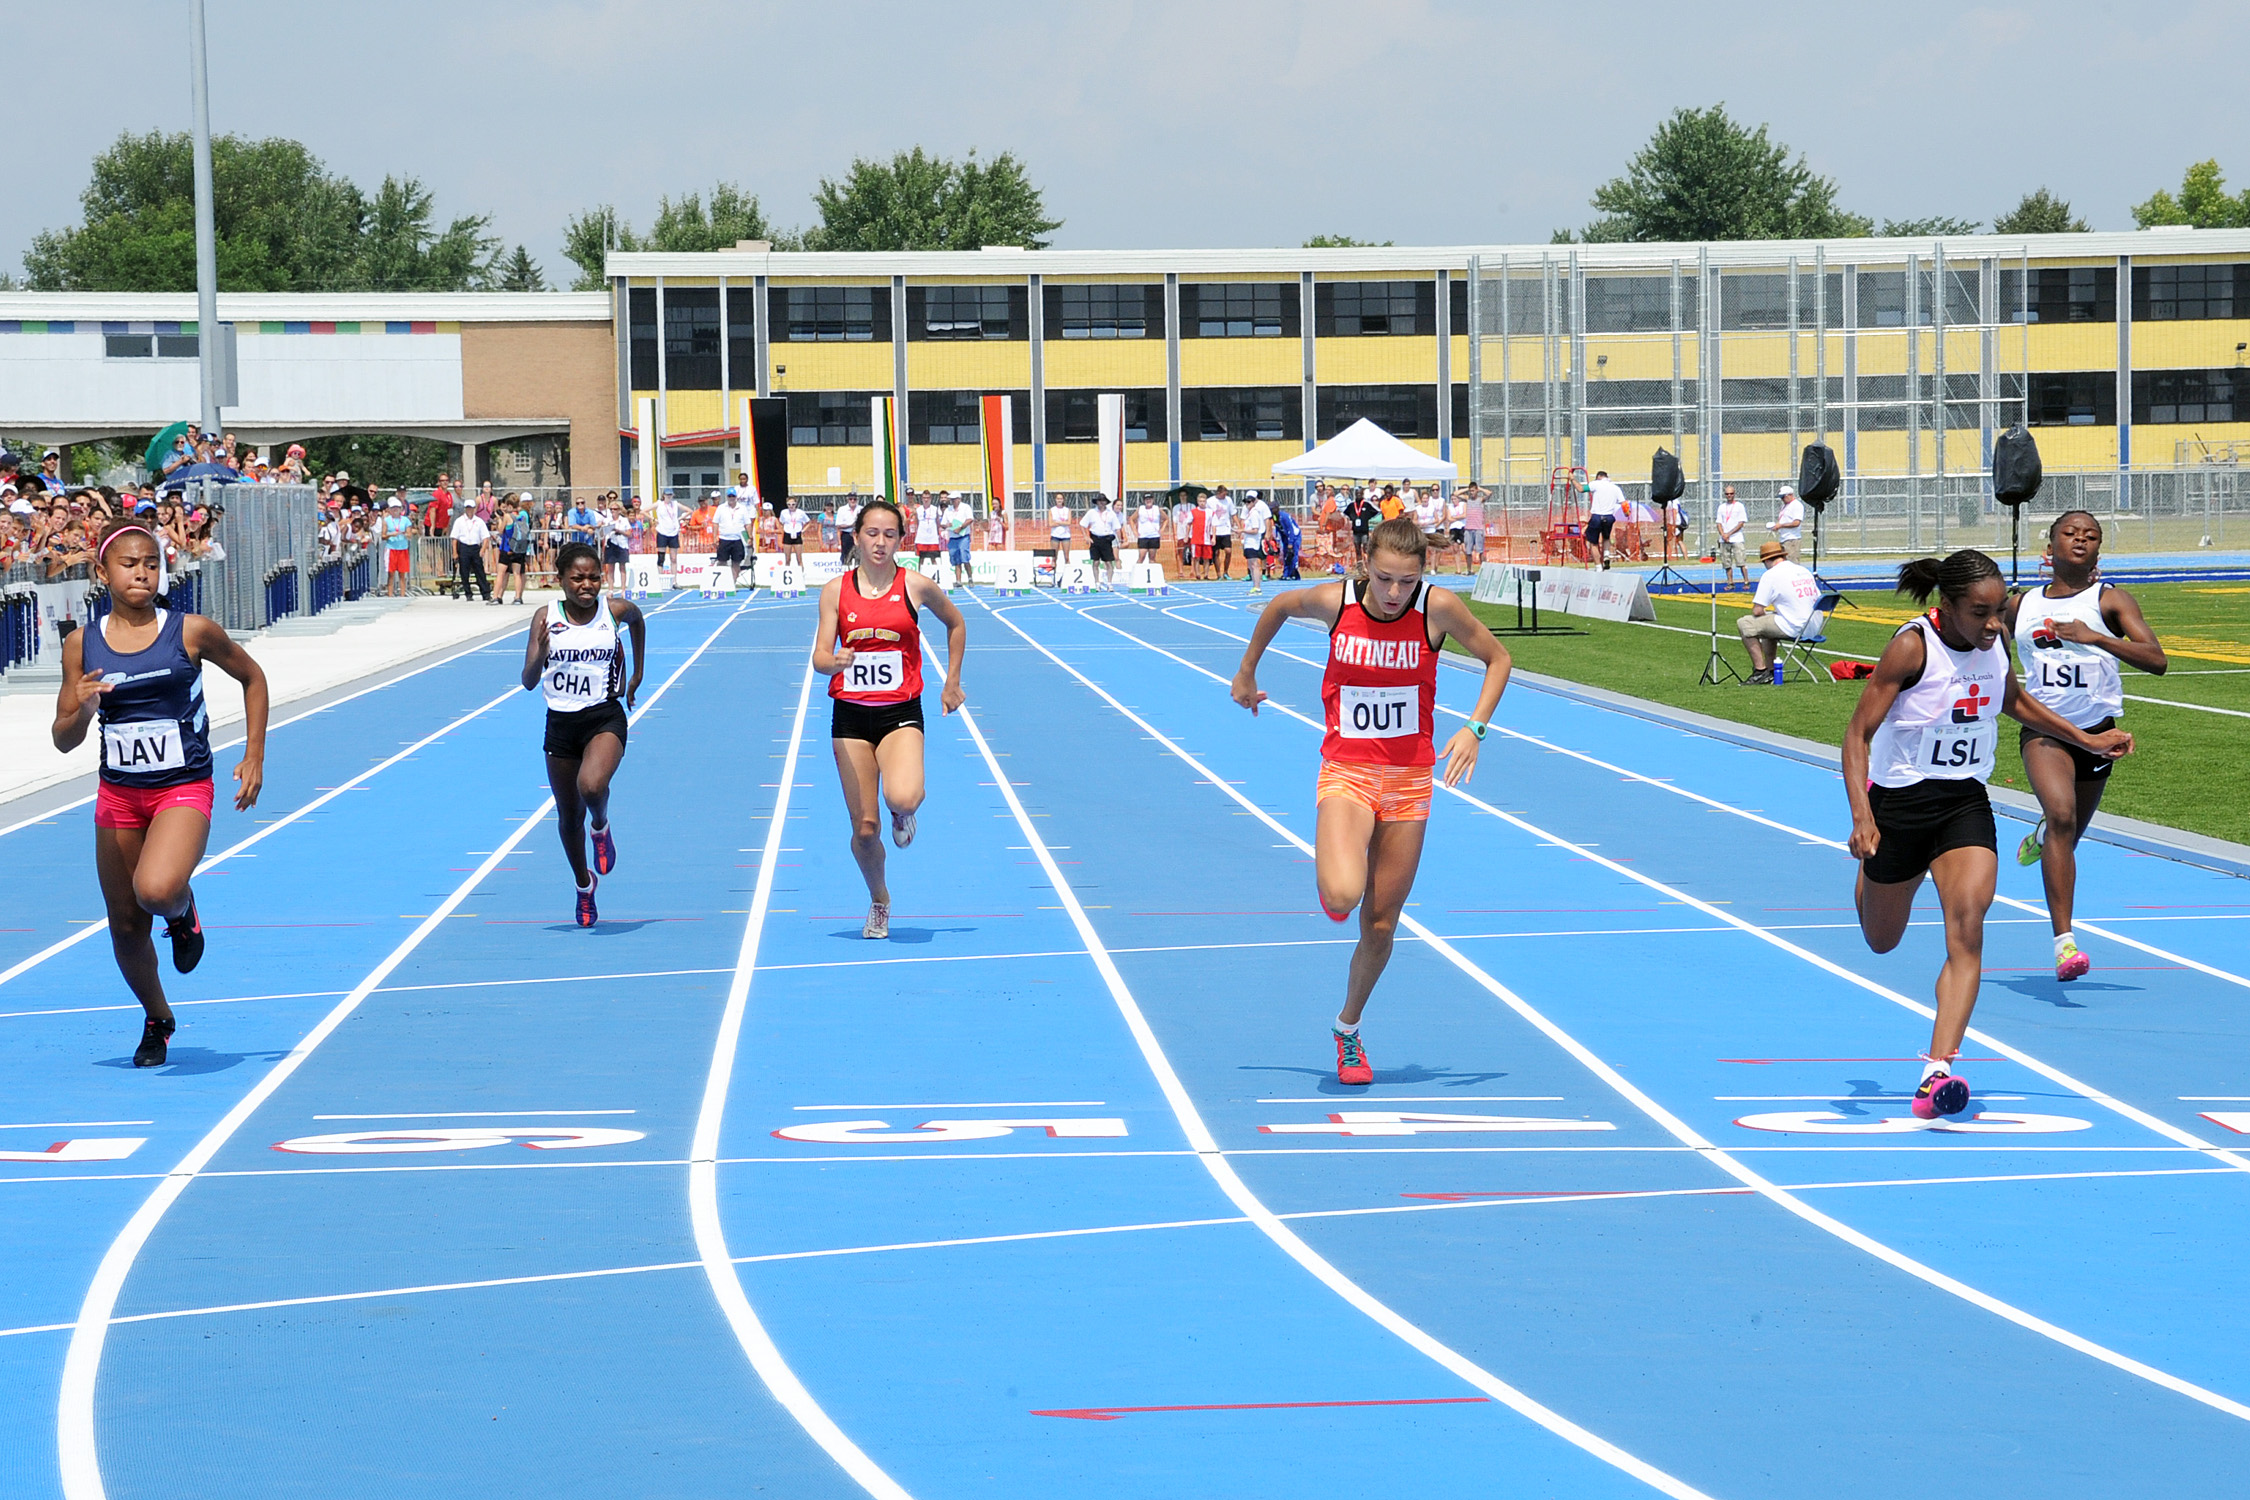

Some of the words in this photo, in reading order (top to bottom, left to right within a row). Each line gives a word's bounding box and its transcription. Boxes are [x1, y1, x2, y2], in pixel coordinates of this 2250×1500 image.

[638, 571, 649, 587] 8
[712, 571, 721, 587] 7
[783, 570, 792, 585] 6
[931, 569, 941, 584] 4
[1008, 568, 1017, 584] 3
[1073, 568, 1083, 583] 2
[1146, 568, 1151, 583] 1
[1334, 632, 1421, 669] GATINEAU
[553, 671, 591, 696] CHA
[853, 664, 893, 685] RIS
[2042, 663, 2088, 688] LSL
[1353, 702, 1407, 731] OUT
[116, 735, 167, 766] LAV
[1931, 738, 1981, 767] LSL
